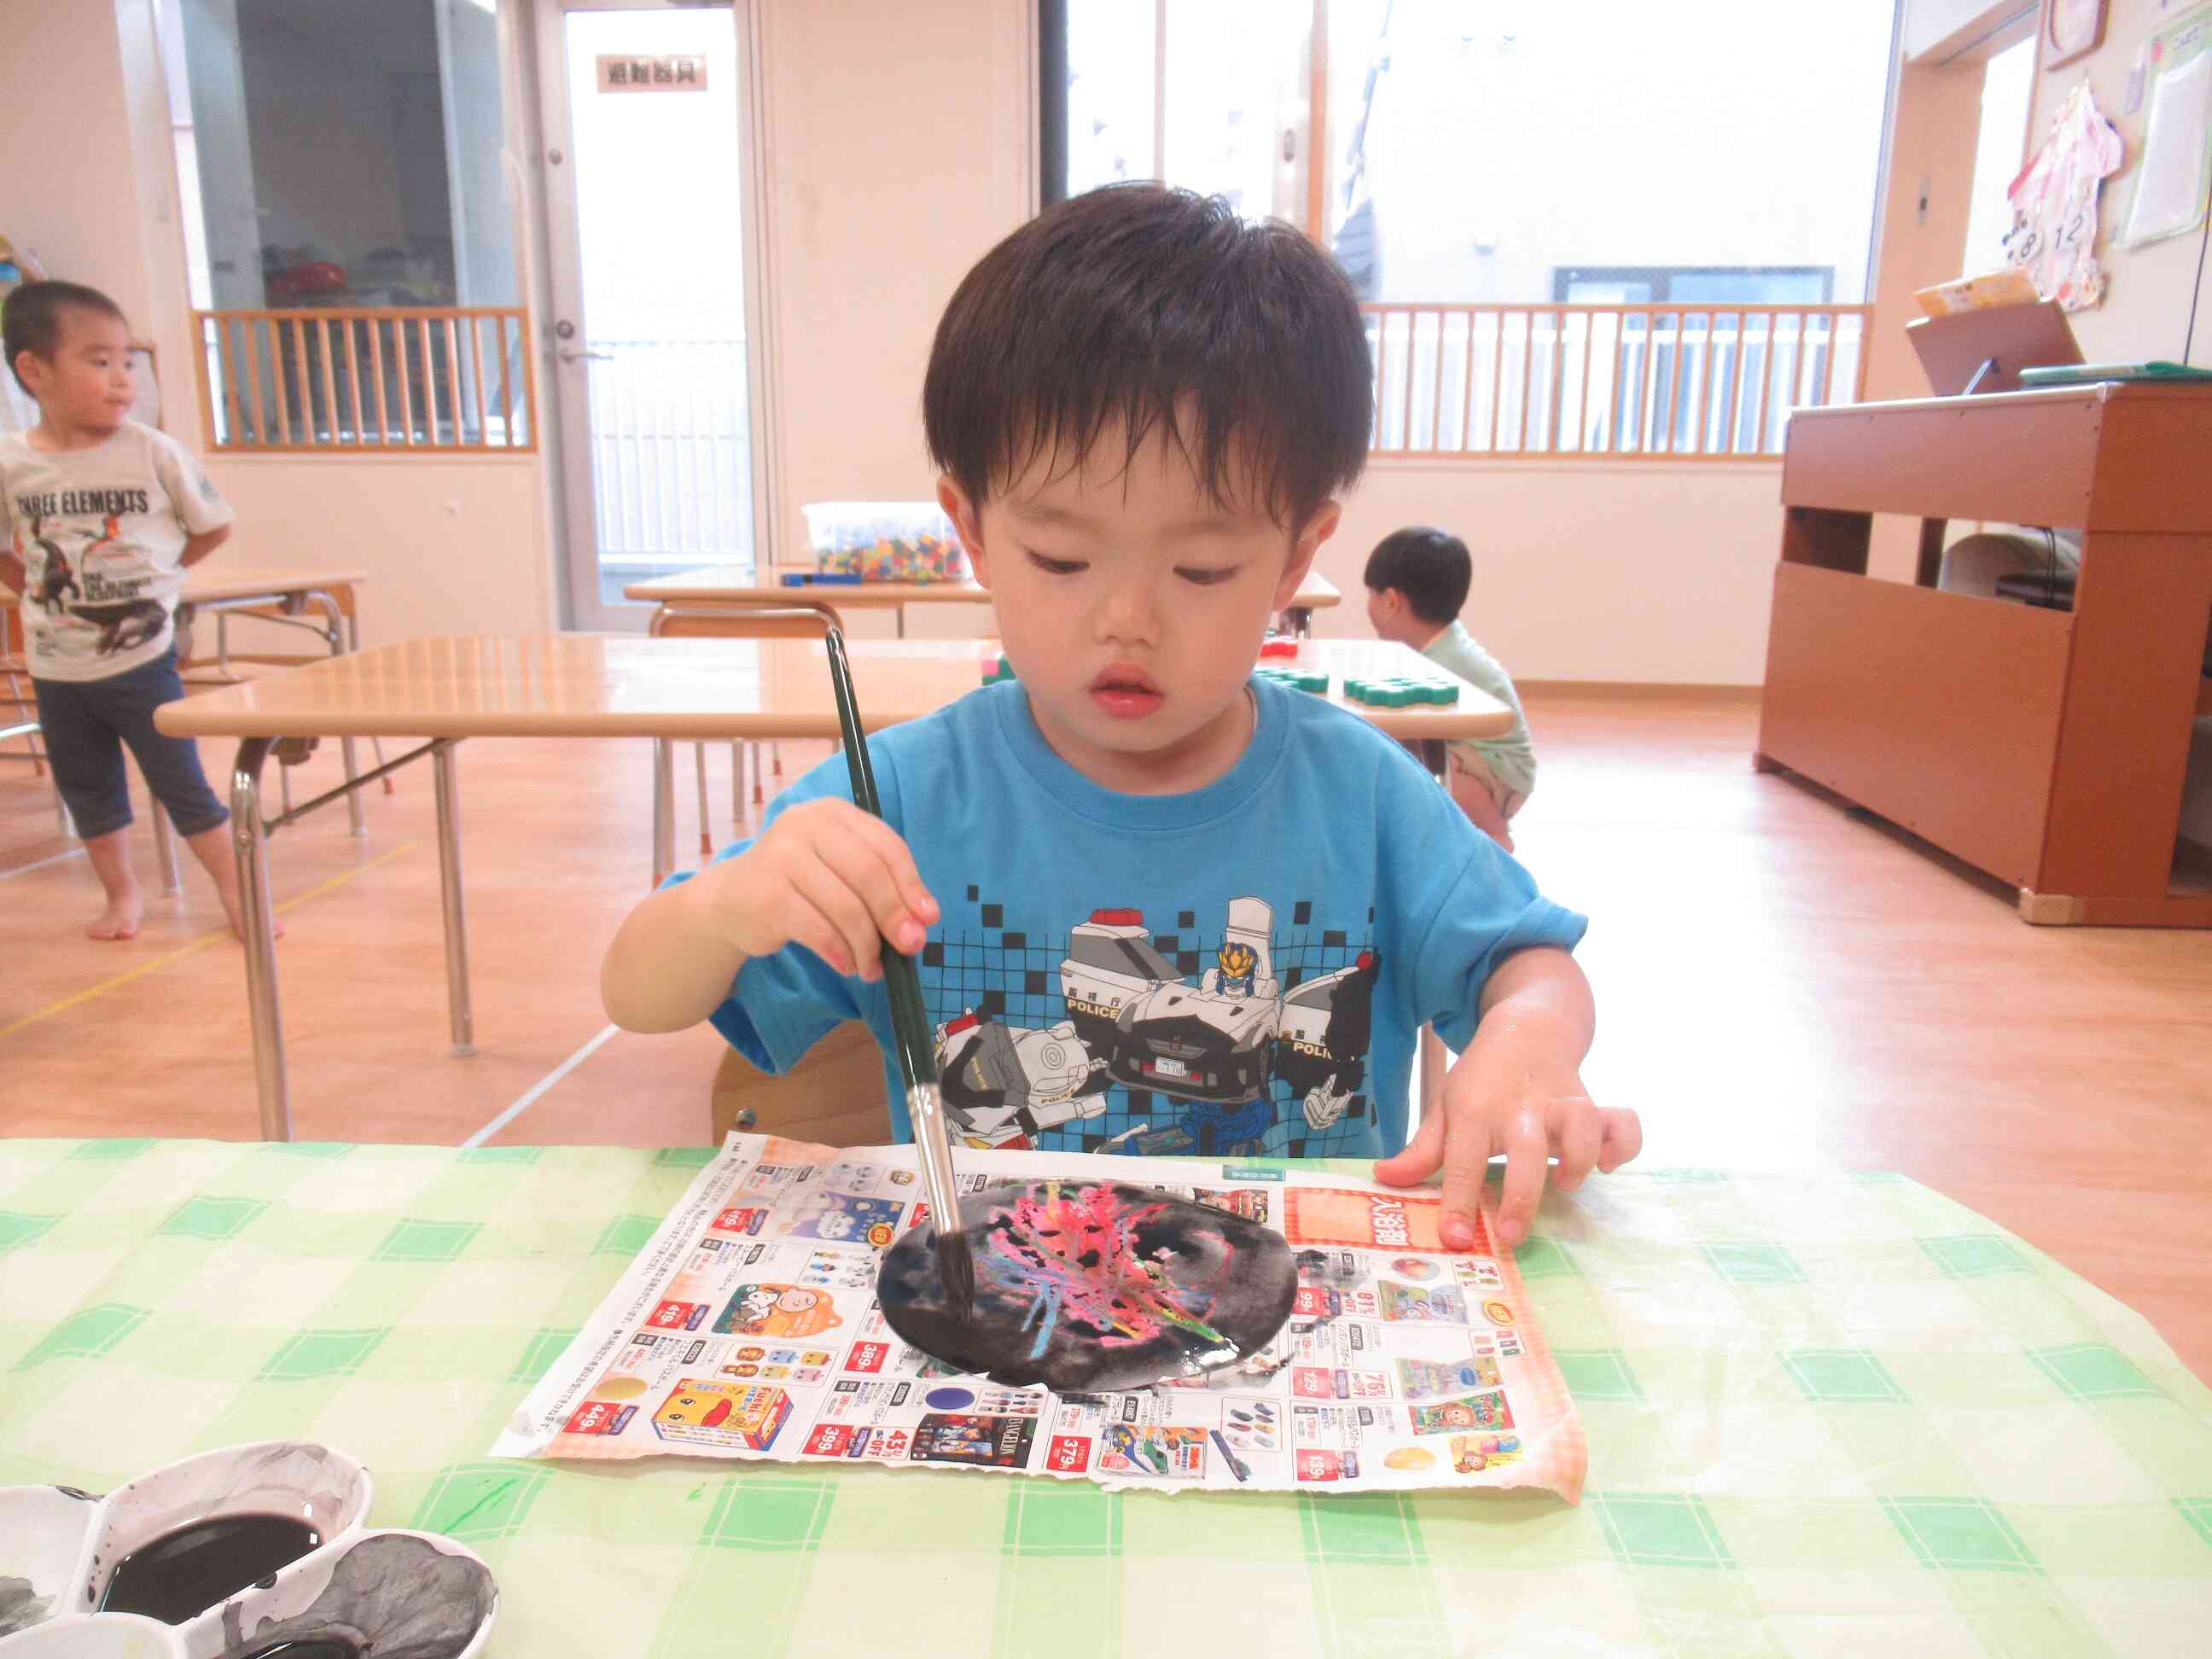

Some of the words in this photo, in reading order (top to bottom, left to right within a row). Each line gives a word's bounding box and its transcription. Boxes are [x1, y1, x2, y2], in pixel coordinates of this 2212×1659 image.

[608, 60, 696, 84] 避難器具
[61, 489, 148, 514] ELEMENTS
[1068, 999, 1120, 1020] POLICE
[1370, 1196, 1410, 1245] 入浴剤
[748, 1387, 771, 1412] Fueki
[815, 1427, 840, 1454] 399円
[882, 1429, 909, 1458] 43%
[998, 1417, 1024, 1454] EVANGELION
[867, 1440, 886, 1458] OFF
[1059, 1439, 1079, 1470] 379円
